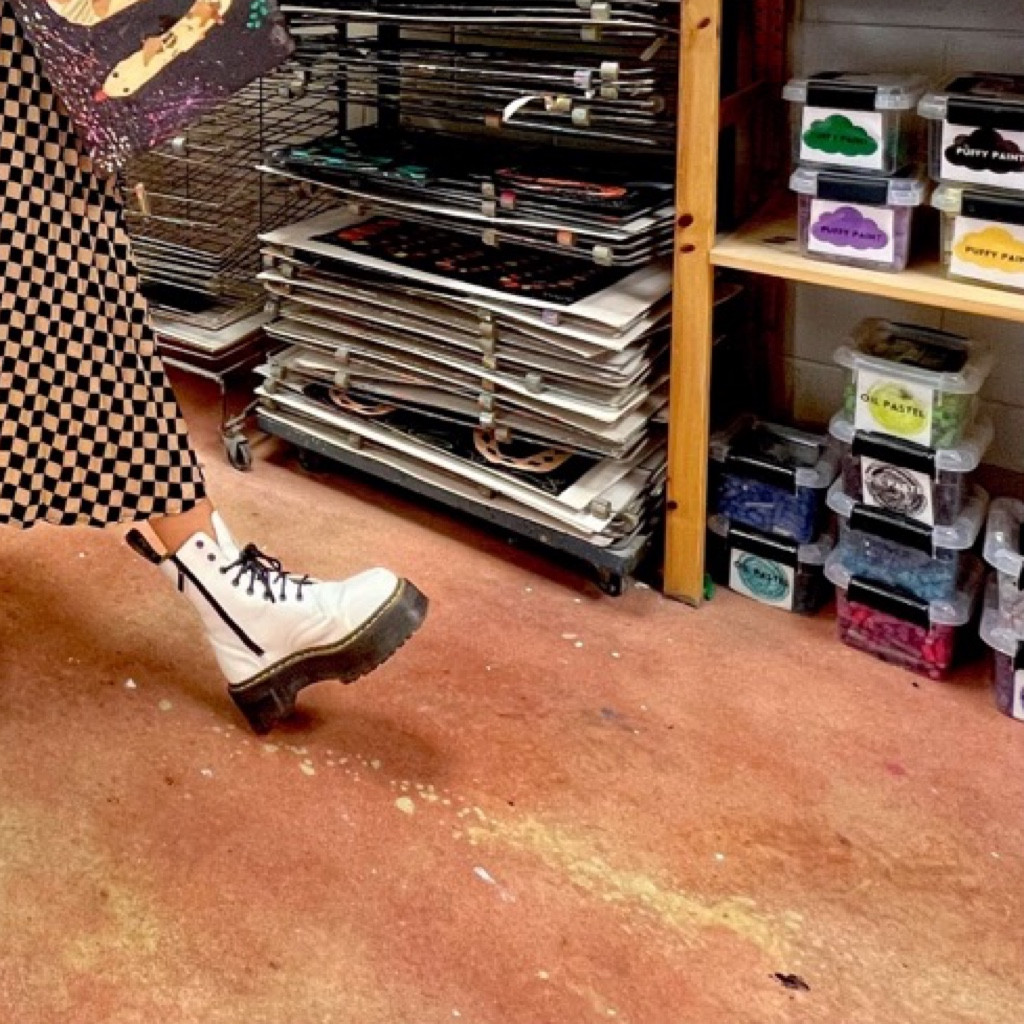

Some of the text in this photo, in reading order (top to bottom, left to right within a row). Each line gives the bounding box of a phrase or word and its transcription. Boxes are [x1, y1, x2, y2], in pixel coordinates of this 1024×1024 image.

[956, 146, 989, 159] PUFFY
[820, 225, 883, 242] PUFFY PAINT
[964, 245, 999, 259] PUFFY
[883, 399, 927, 420] PASTEL
